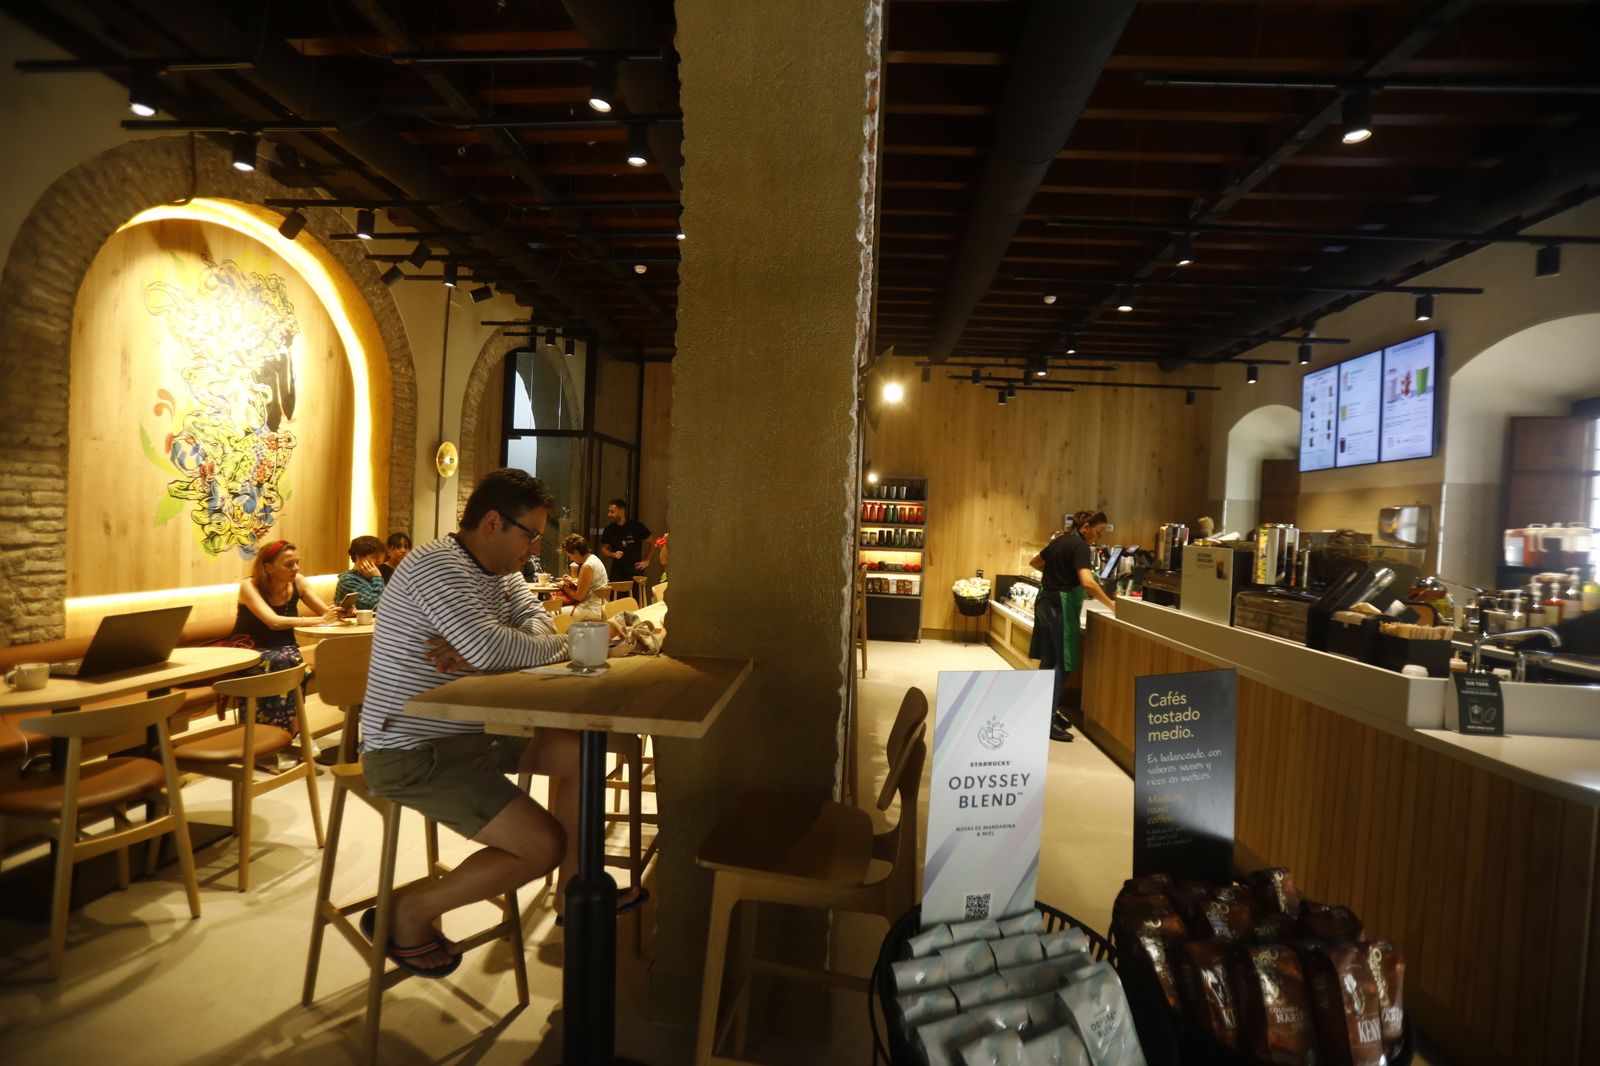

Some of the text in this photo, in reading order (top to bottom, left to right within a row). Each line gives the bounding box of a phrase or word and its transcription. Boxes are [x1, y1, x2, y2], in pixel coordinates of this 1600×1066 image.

[1148, 690, 1187, 708] Cafés
[1147, 707, 1201, 725] tostado
[1148, 726, 1195, 742] medio.
[1208, 749, 1222, 759] con
[948, 773, 1031, 790] ODYSSEY
[983, 823, 1016, 831] MANDARINA
